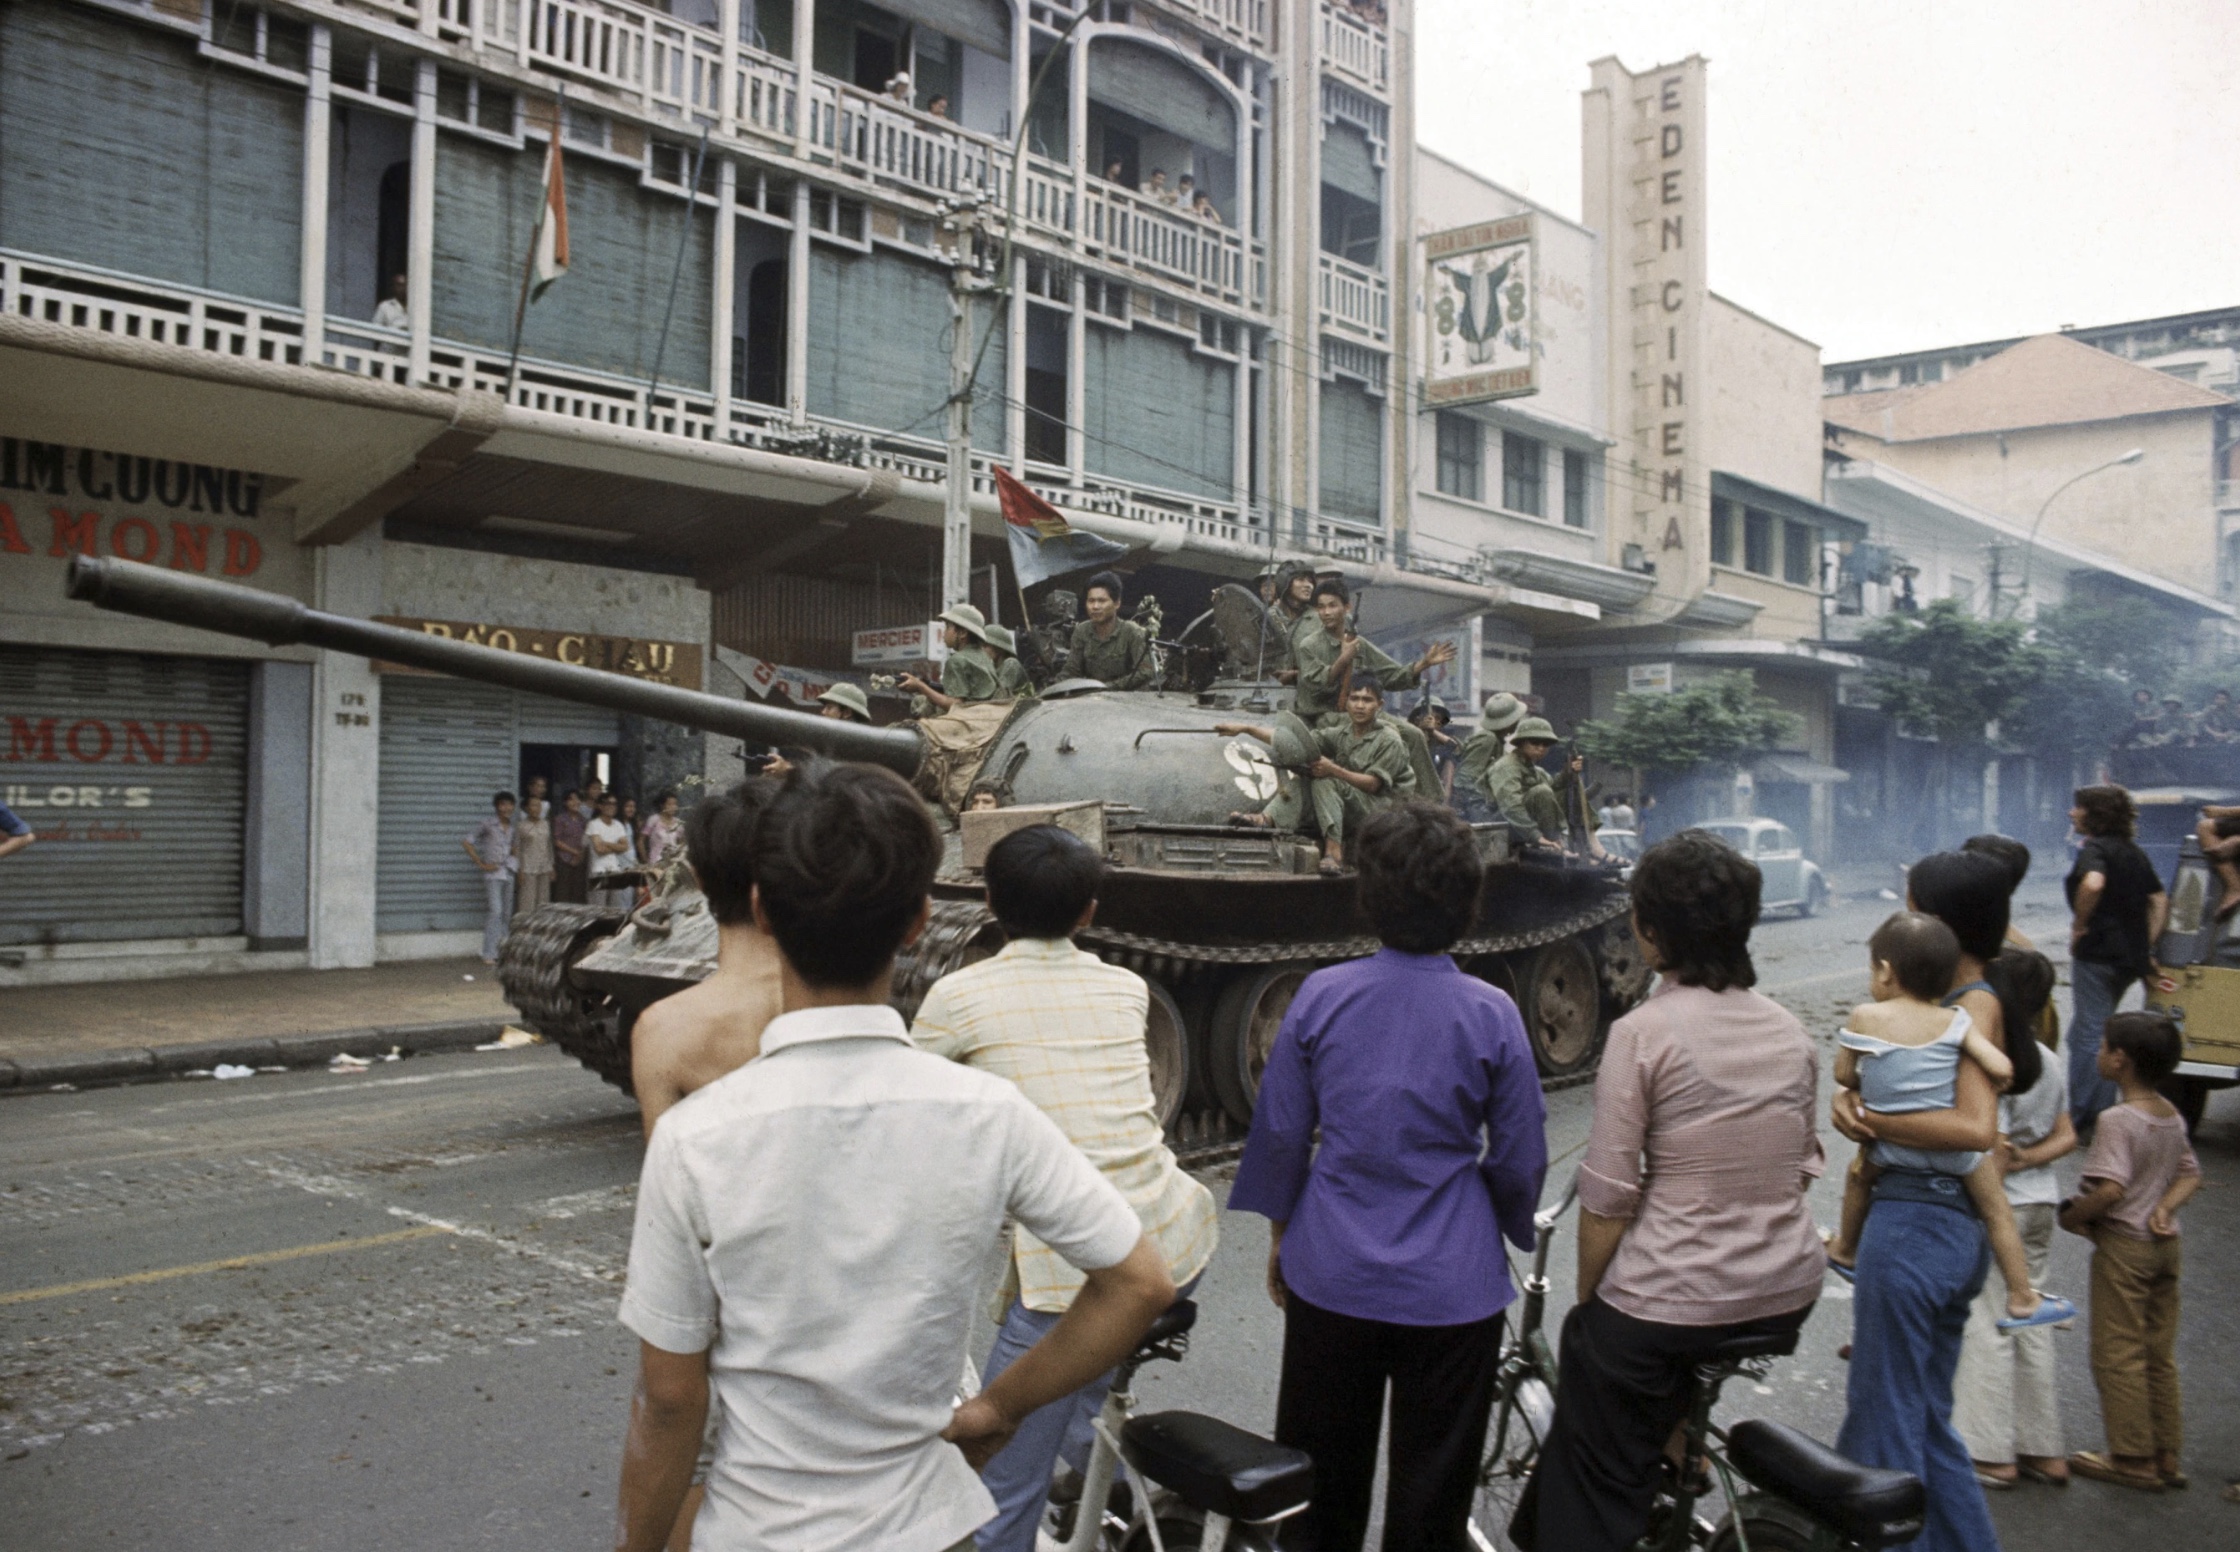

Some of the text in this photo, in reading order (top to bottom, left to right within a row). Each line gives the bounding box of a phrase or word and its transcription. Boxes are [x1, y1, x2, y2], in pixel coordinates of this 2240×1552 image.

[1661, 75, 1685, 551] EDEN CINEMA
[857, 629, 922, 649] MERCIER
[0, 715, 213, 765] MOND
